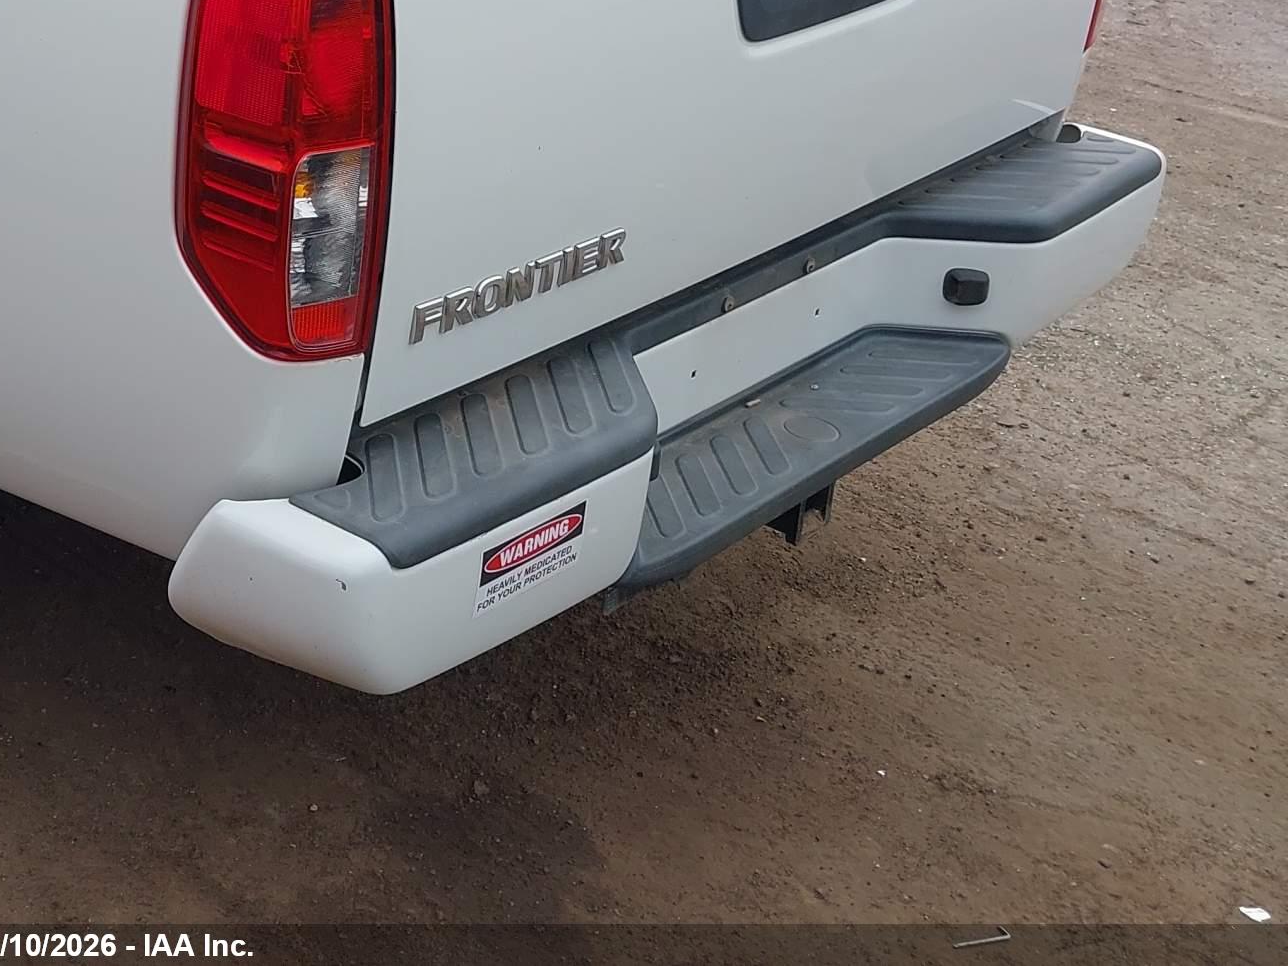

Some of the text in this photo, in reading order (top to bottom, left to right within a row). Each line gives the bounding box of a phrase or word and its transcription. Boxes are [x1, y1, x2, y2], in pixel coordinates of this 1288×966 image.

[408, 226, 627, 346] FRONTIER
[486, 545, 573, 597] HEAVILY MEDICATED
[499, 519, 570, 568] WARNING
[476, 552, 578, 612] FOR YOUR PROTECTION
